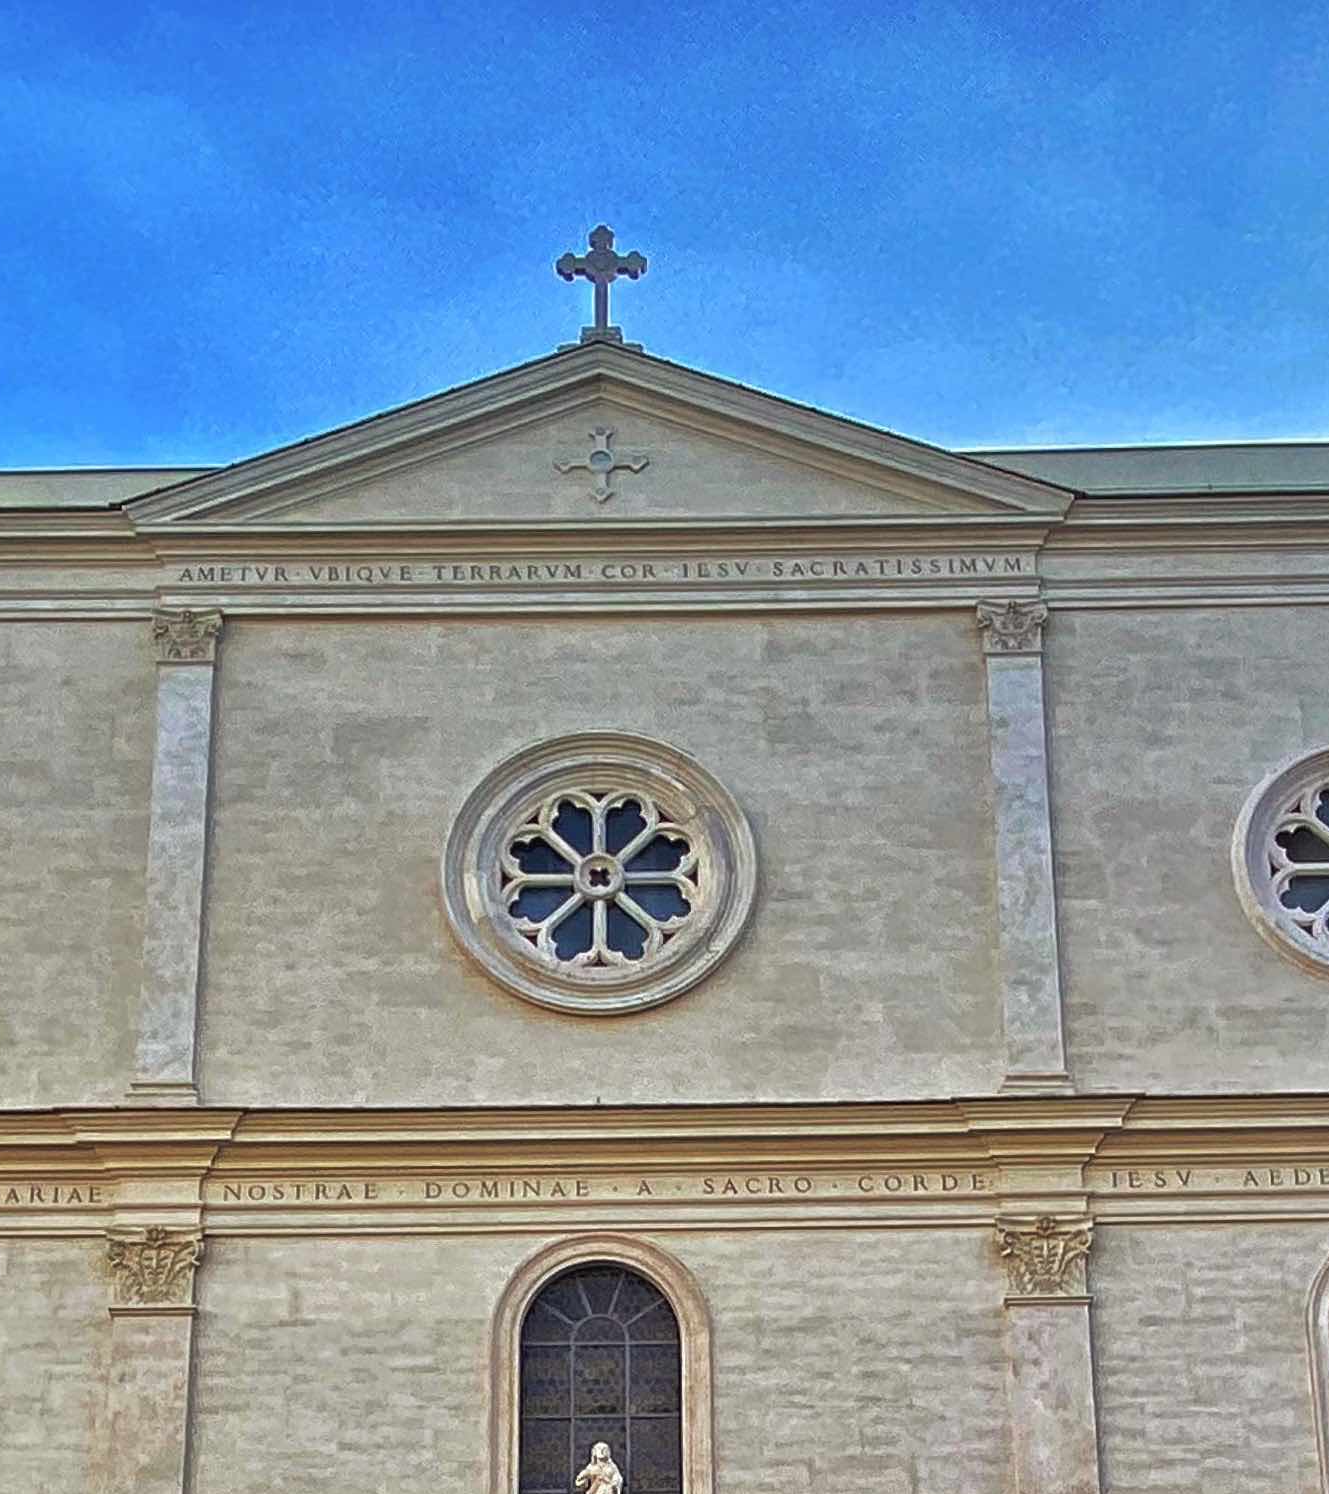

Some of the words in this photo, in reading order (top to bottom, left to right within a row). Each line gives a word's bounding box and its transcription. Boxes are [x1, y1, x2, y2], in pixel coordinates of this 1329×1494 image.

[179, 565, 288, 582] AMETVR
[433, 563, 583, 581] TERRARVM
[601, 563, 655, 580] COR
[682, 562, 750, 578] IESV
[772, 556, 1023, 577] SACRATISSIMVM
[222, 1180, 379, 1202] NOSTRAE
[424, 1180, 592, 1200] DOMINAE
[700, 1177, 814, 1195] SACRO
[856, 1172, 988, 1193] CORDE
[1110, 1169, 1193, 1189] IESV
